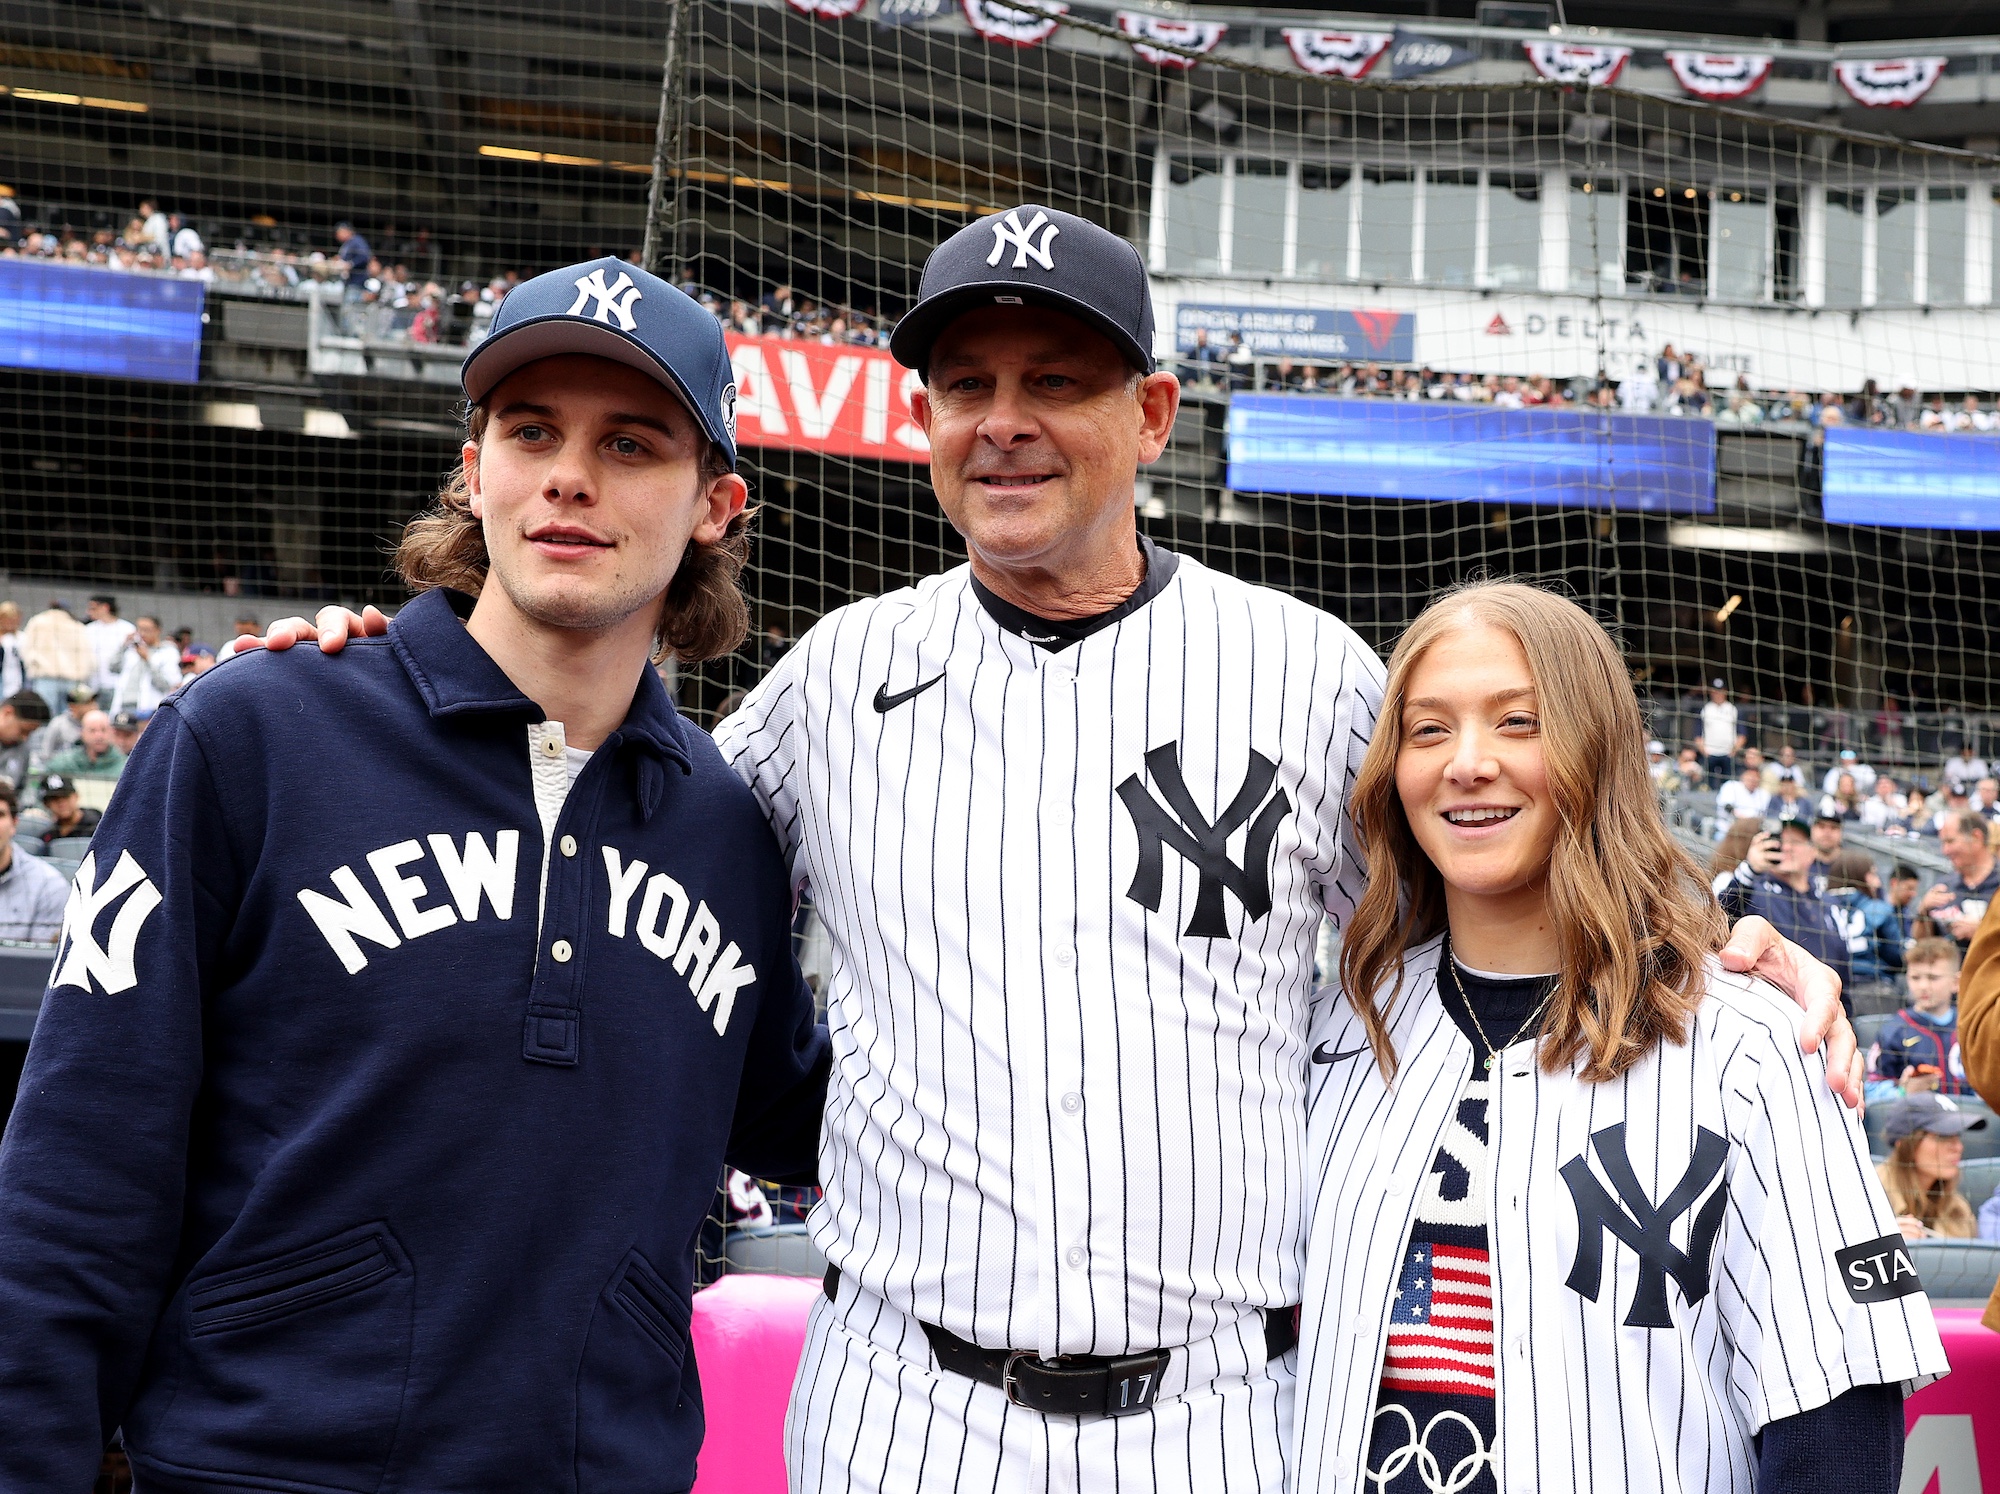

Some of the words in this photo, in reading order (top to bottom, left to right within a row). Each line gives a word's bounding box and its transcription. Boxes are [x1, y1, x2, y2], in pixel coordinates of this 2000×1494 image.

[987, 210, 1060, 271] NY
[566, 268, 643, 332] NY
[1527, 313, 1646, 341] DELTA
[1115, 739, 1292, 939] NY
[49, 848, 163, 996] NY
[297, 829, 520, 975] NEW
[601, 845, 757, 1037] YORK
[1559, 1121, 1730, 1328] NY
[1848, 1248, 1918, 1291] STA
[1119, 1373, 1152, 1408] 17
